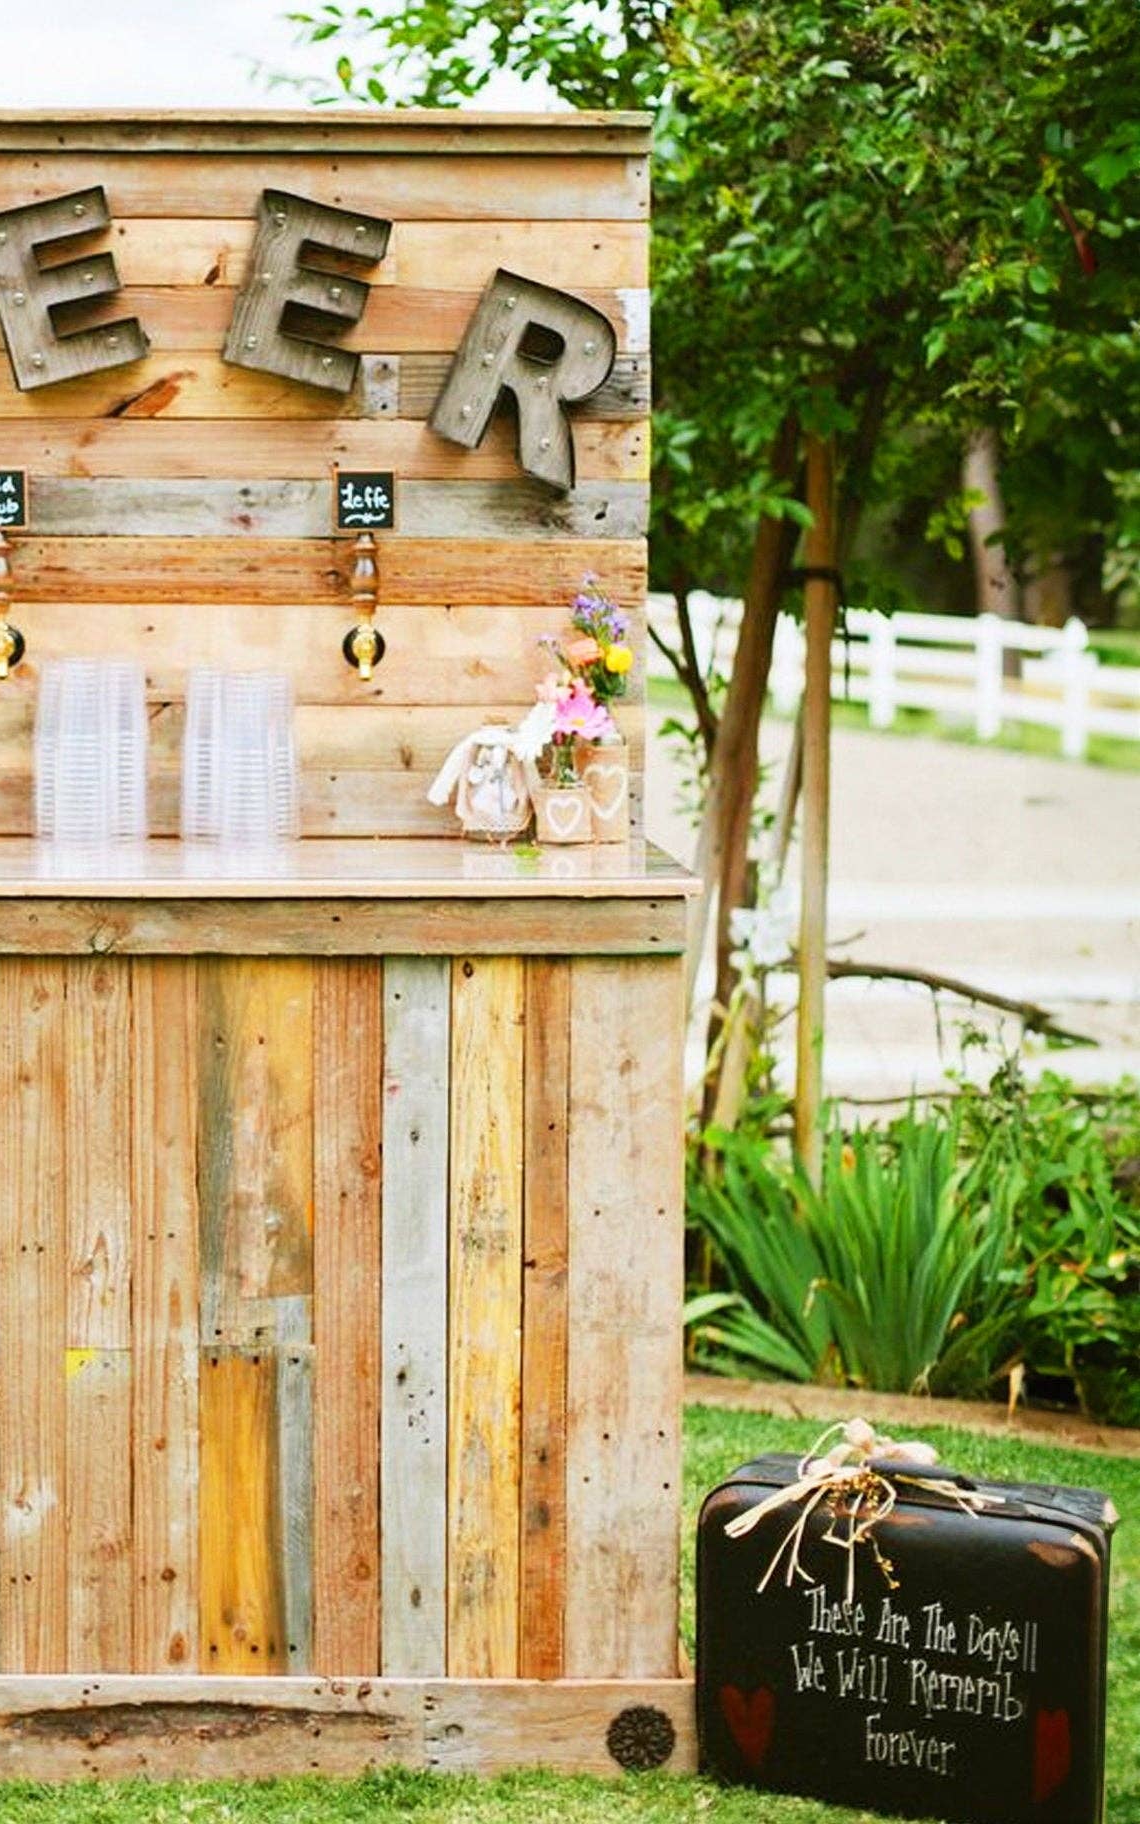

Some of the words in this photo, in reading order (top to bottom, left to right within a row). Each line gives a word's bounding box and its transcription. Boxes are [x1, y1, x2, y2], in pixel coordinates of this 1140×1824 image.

[803, 1583, 866, 1636] These
[874, 1597, 910, 1650] Are
[922, 1601, 957, 1654] The
[789, 1640, 827, 1693] We
[836, 1646, 889, 1704] Will
[865, 1712, 957, 1776] Forever
